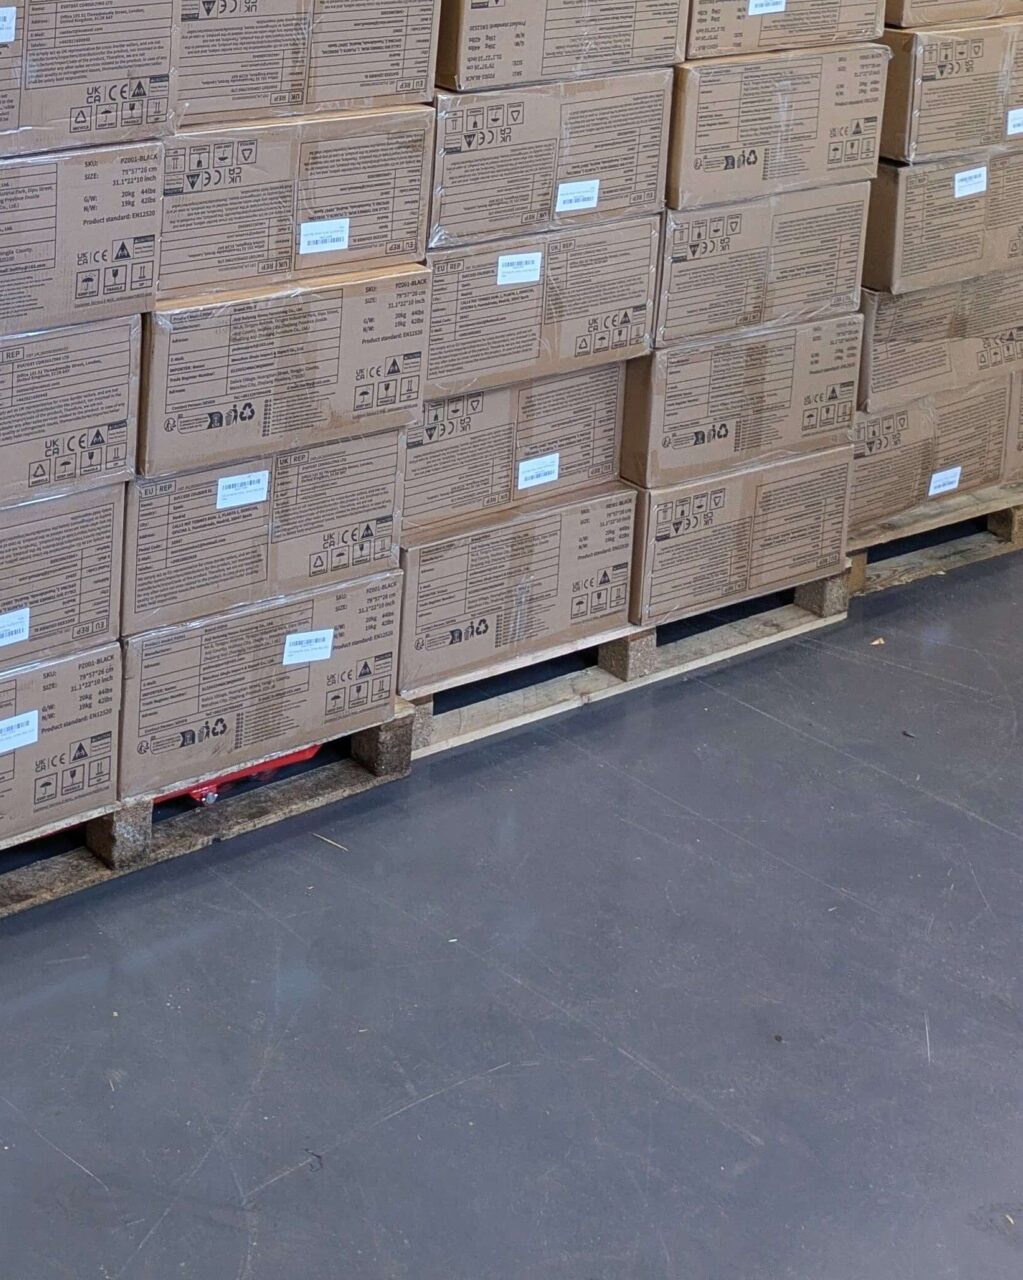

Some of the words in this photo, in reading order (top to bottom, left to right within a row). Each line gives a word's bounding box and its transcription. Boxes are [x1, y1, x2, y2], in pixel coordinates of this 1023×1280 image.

[86, 86, 101, 95] UK
[121, 154, 157, 164] PZ001-BLACK
[106, 214, 131, 223] standard:
[132, 211, 155, 219] EN12520
[45, 440, 60, 448] UK
[159, 484, 172, 492] REP
[76, 625, 89, 634] REP
[78, 655, 114, 669] PZ001-BLACK
[102, 675, 113, 684] inch
[79, 694, 92, 702] 20kg
[41, 725, 62, 734] Product
[64, 717, 89, 728] standard:
[90, 709, 112, 720] EN12520
